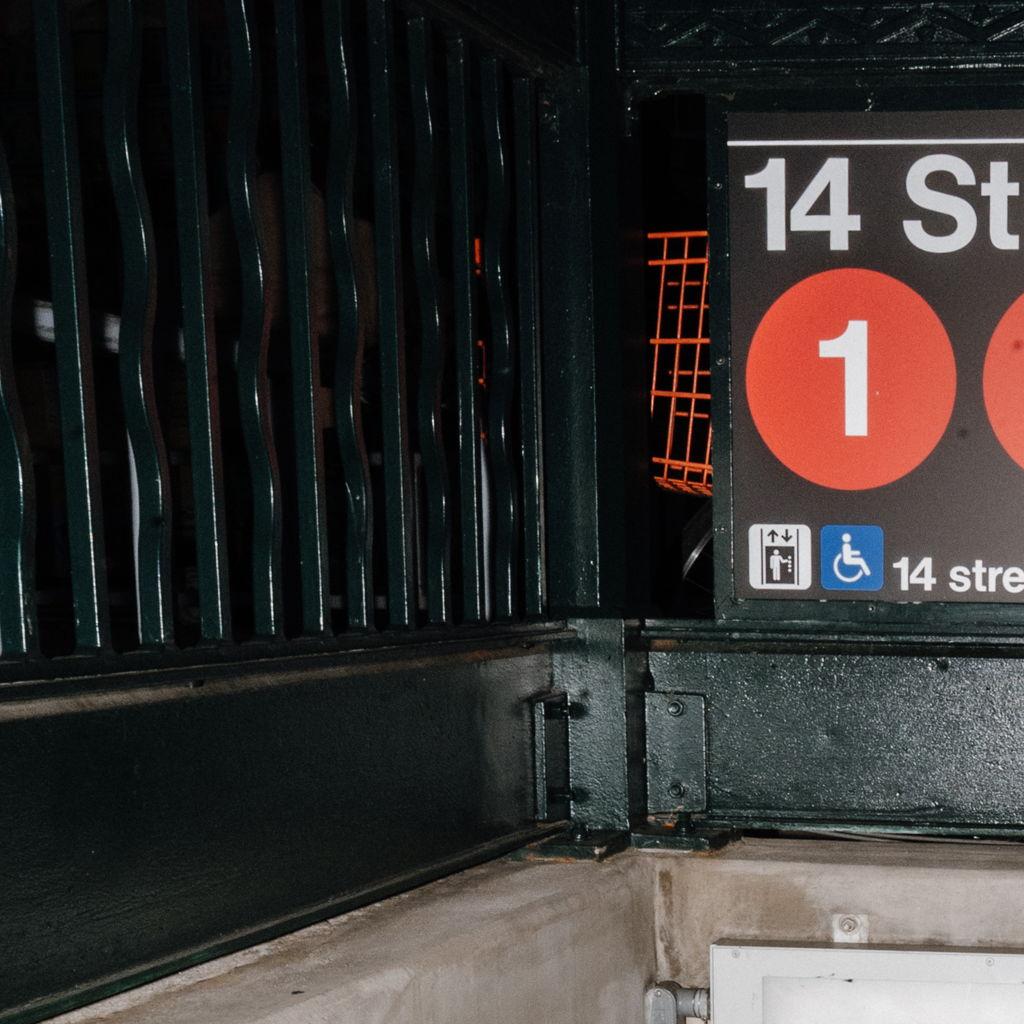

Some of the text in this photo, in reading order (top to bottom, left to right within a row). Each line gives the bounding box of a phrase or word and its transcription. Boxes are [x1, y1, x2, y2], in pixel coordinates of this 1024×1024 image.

[745, 158, 860, 252] 14
[819, 320, 868, 436] 1
[891, 557, 937, 592] 14
